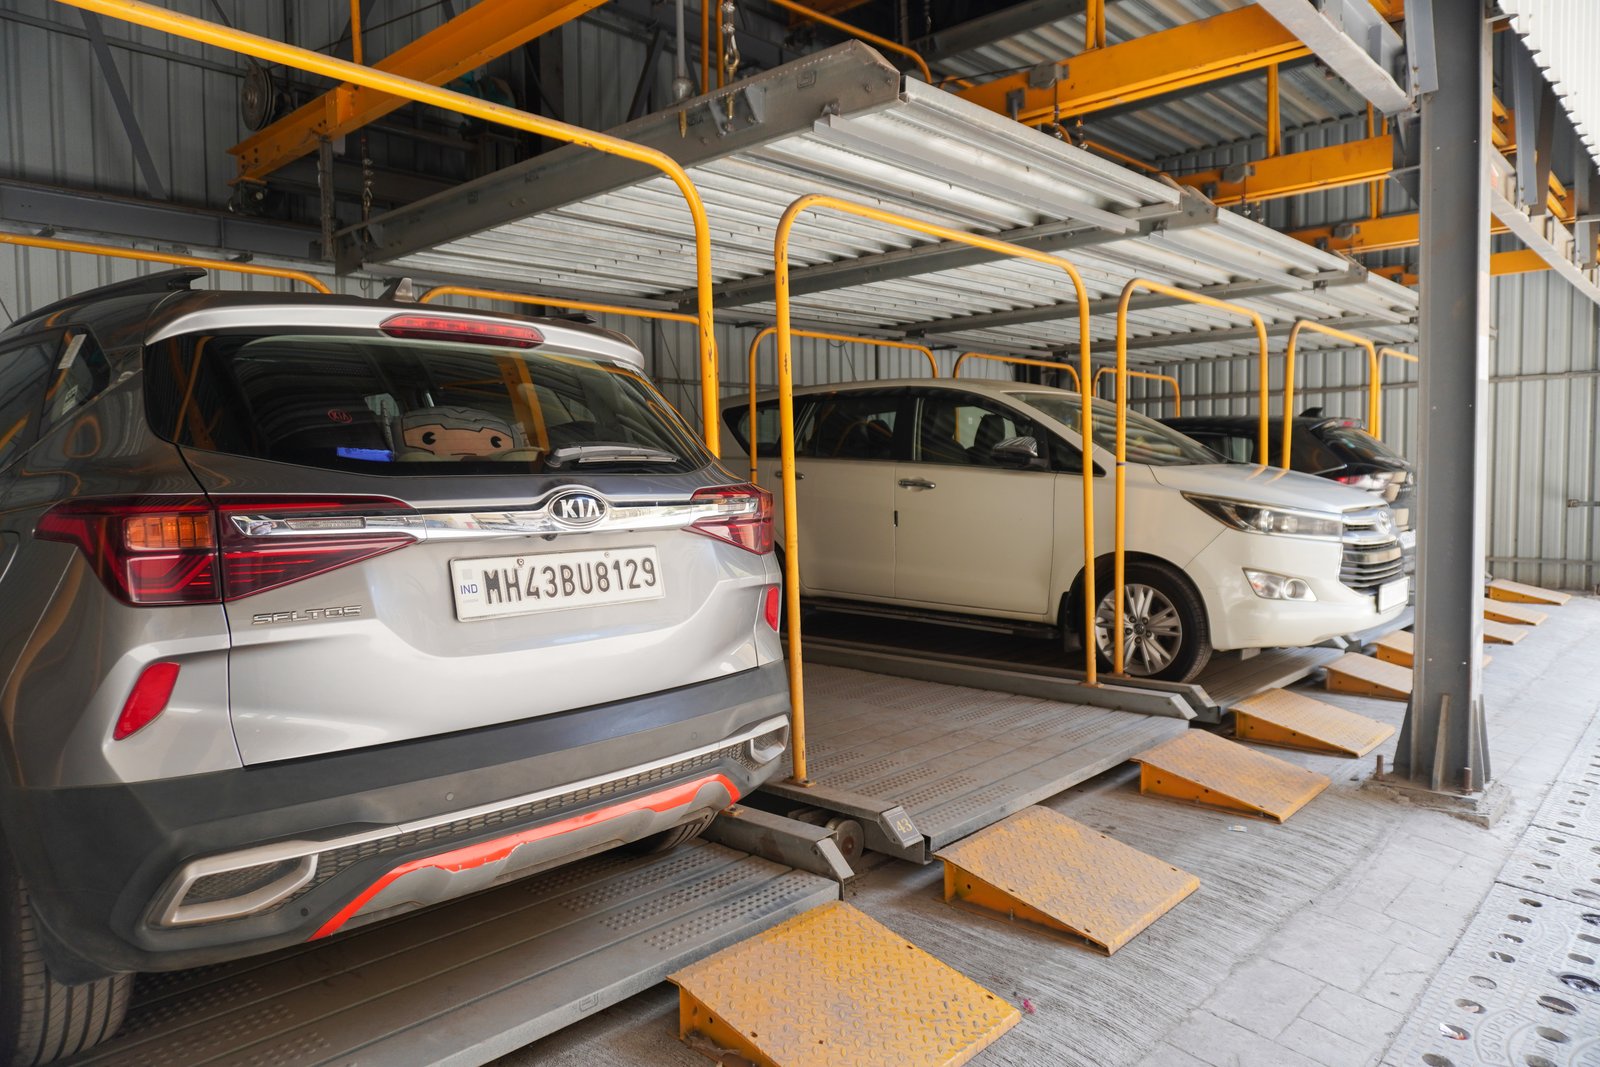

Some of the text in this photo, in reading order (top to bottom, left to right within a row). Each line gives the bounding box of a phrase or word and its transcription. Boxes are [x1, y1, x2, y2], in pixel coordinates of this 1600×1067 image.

[559, 498, 602, 519] KIA
[460, 583, 478, 595] IND
[483, 557, 657, 605] MH43BU8129
[251, 604, 362, 625] SELTOS
[896, 818, 913, 833] 43
